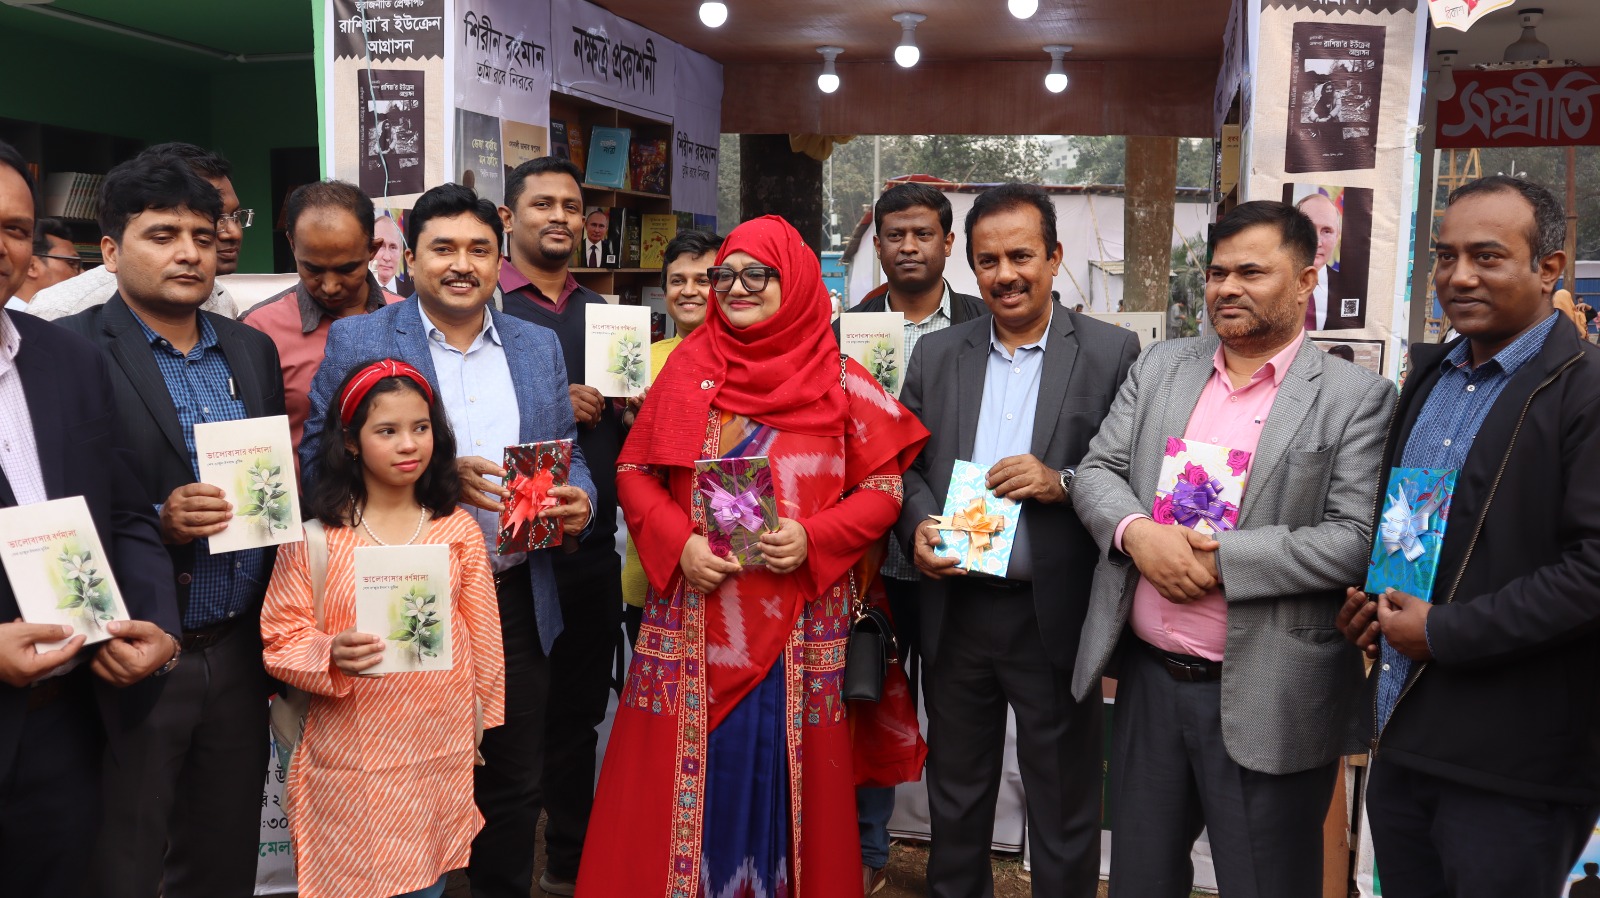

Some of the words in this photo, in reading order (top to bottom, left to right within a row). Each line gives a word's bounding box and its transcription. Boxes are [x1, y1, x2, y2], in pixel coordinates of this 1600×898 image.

[393, 13, 442, 33] ইউক্রেন
[367, 38, 414, 54] আগ্রাসন
[463, 11, 502, 58] শিরীন
[505, 34, 545, 71] রহমান
[572, 26, 610, 82] নক্ষত্র
[612, 38, 657, 96] প্রকাশনী
[1441, 71, 1600, 140] সম্প্রীতি
[206, 448, 247, 459] ভালোবাসার
[248, 445, 272, 455] বর্ণমালা
[7, 534, 52, 548] ভালোবাসার
[52, 529, 77, 540] বর্ণমালা
[362, 575, 403, 583] ভালোবাসার
[404, 573, 429, 582] বর্ণমালা
